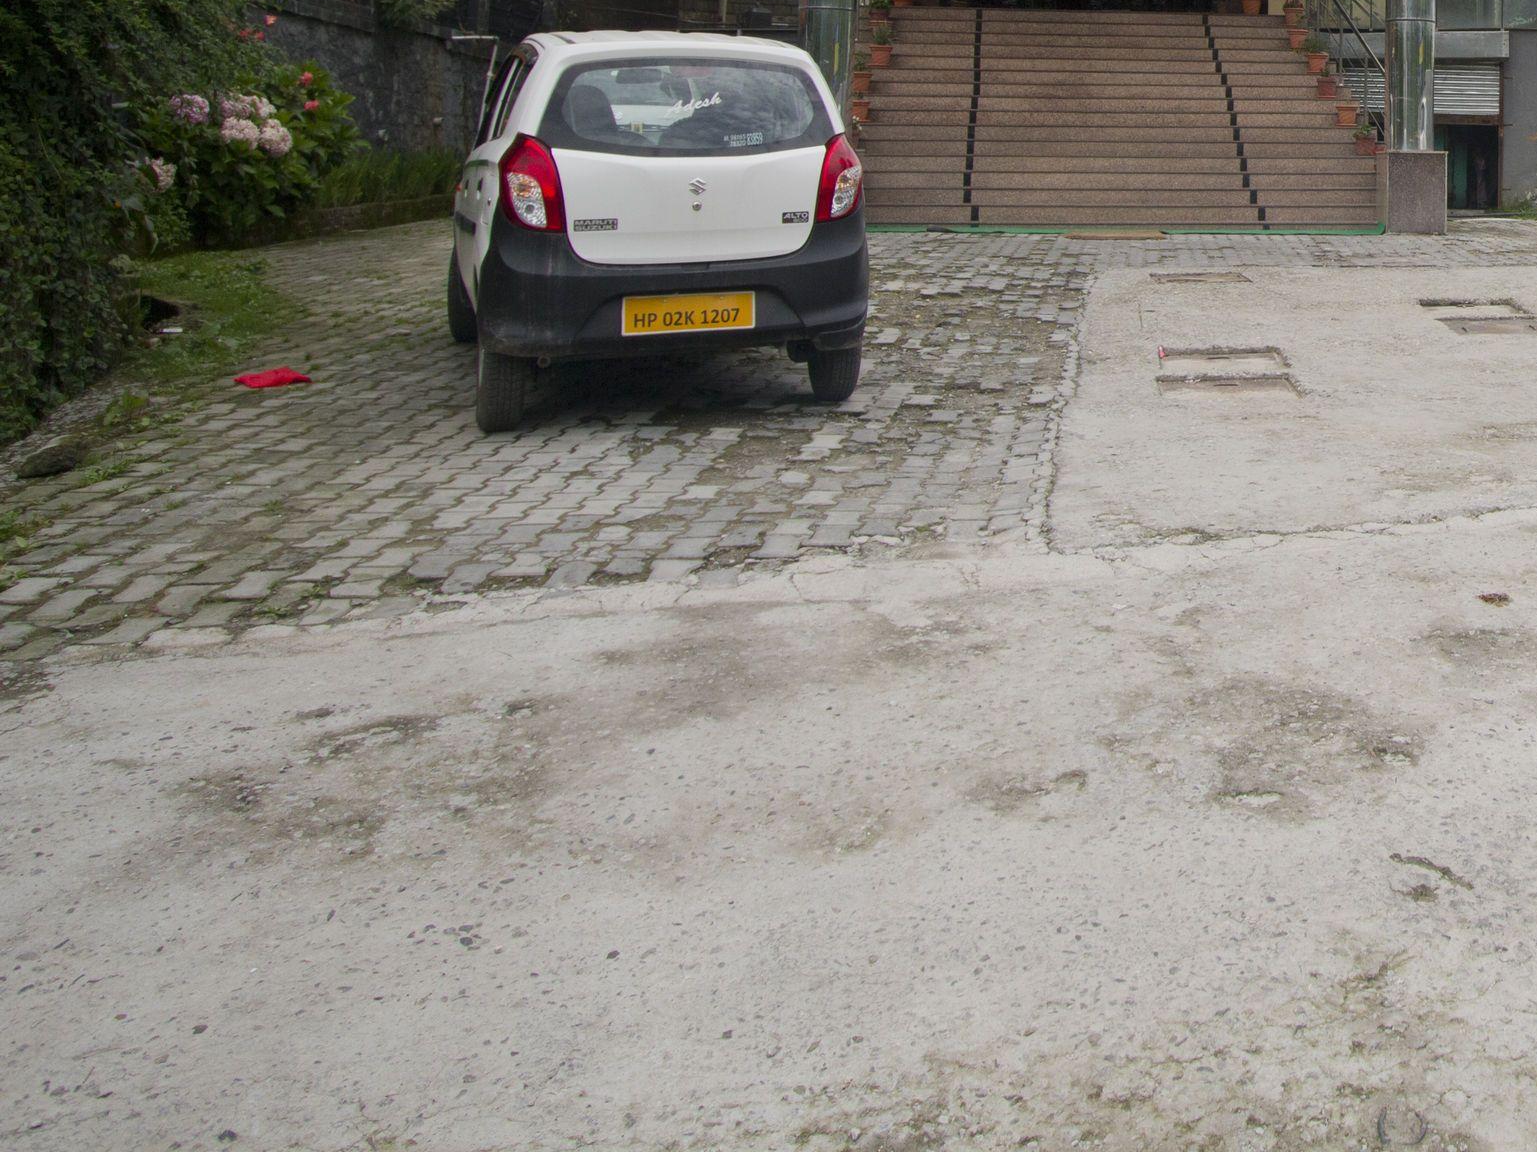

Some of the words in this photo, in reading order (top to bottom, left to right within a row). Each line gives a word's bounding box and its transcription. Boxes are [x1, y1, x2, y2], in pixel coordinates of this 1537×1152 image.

[634, 312, 657, 328] HP
[663, 310, 695, 327] 02K
[700, 307, 740, 325] 1207
